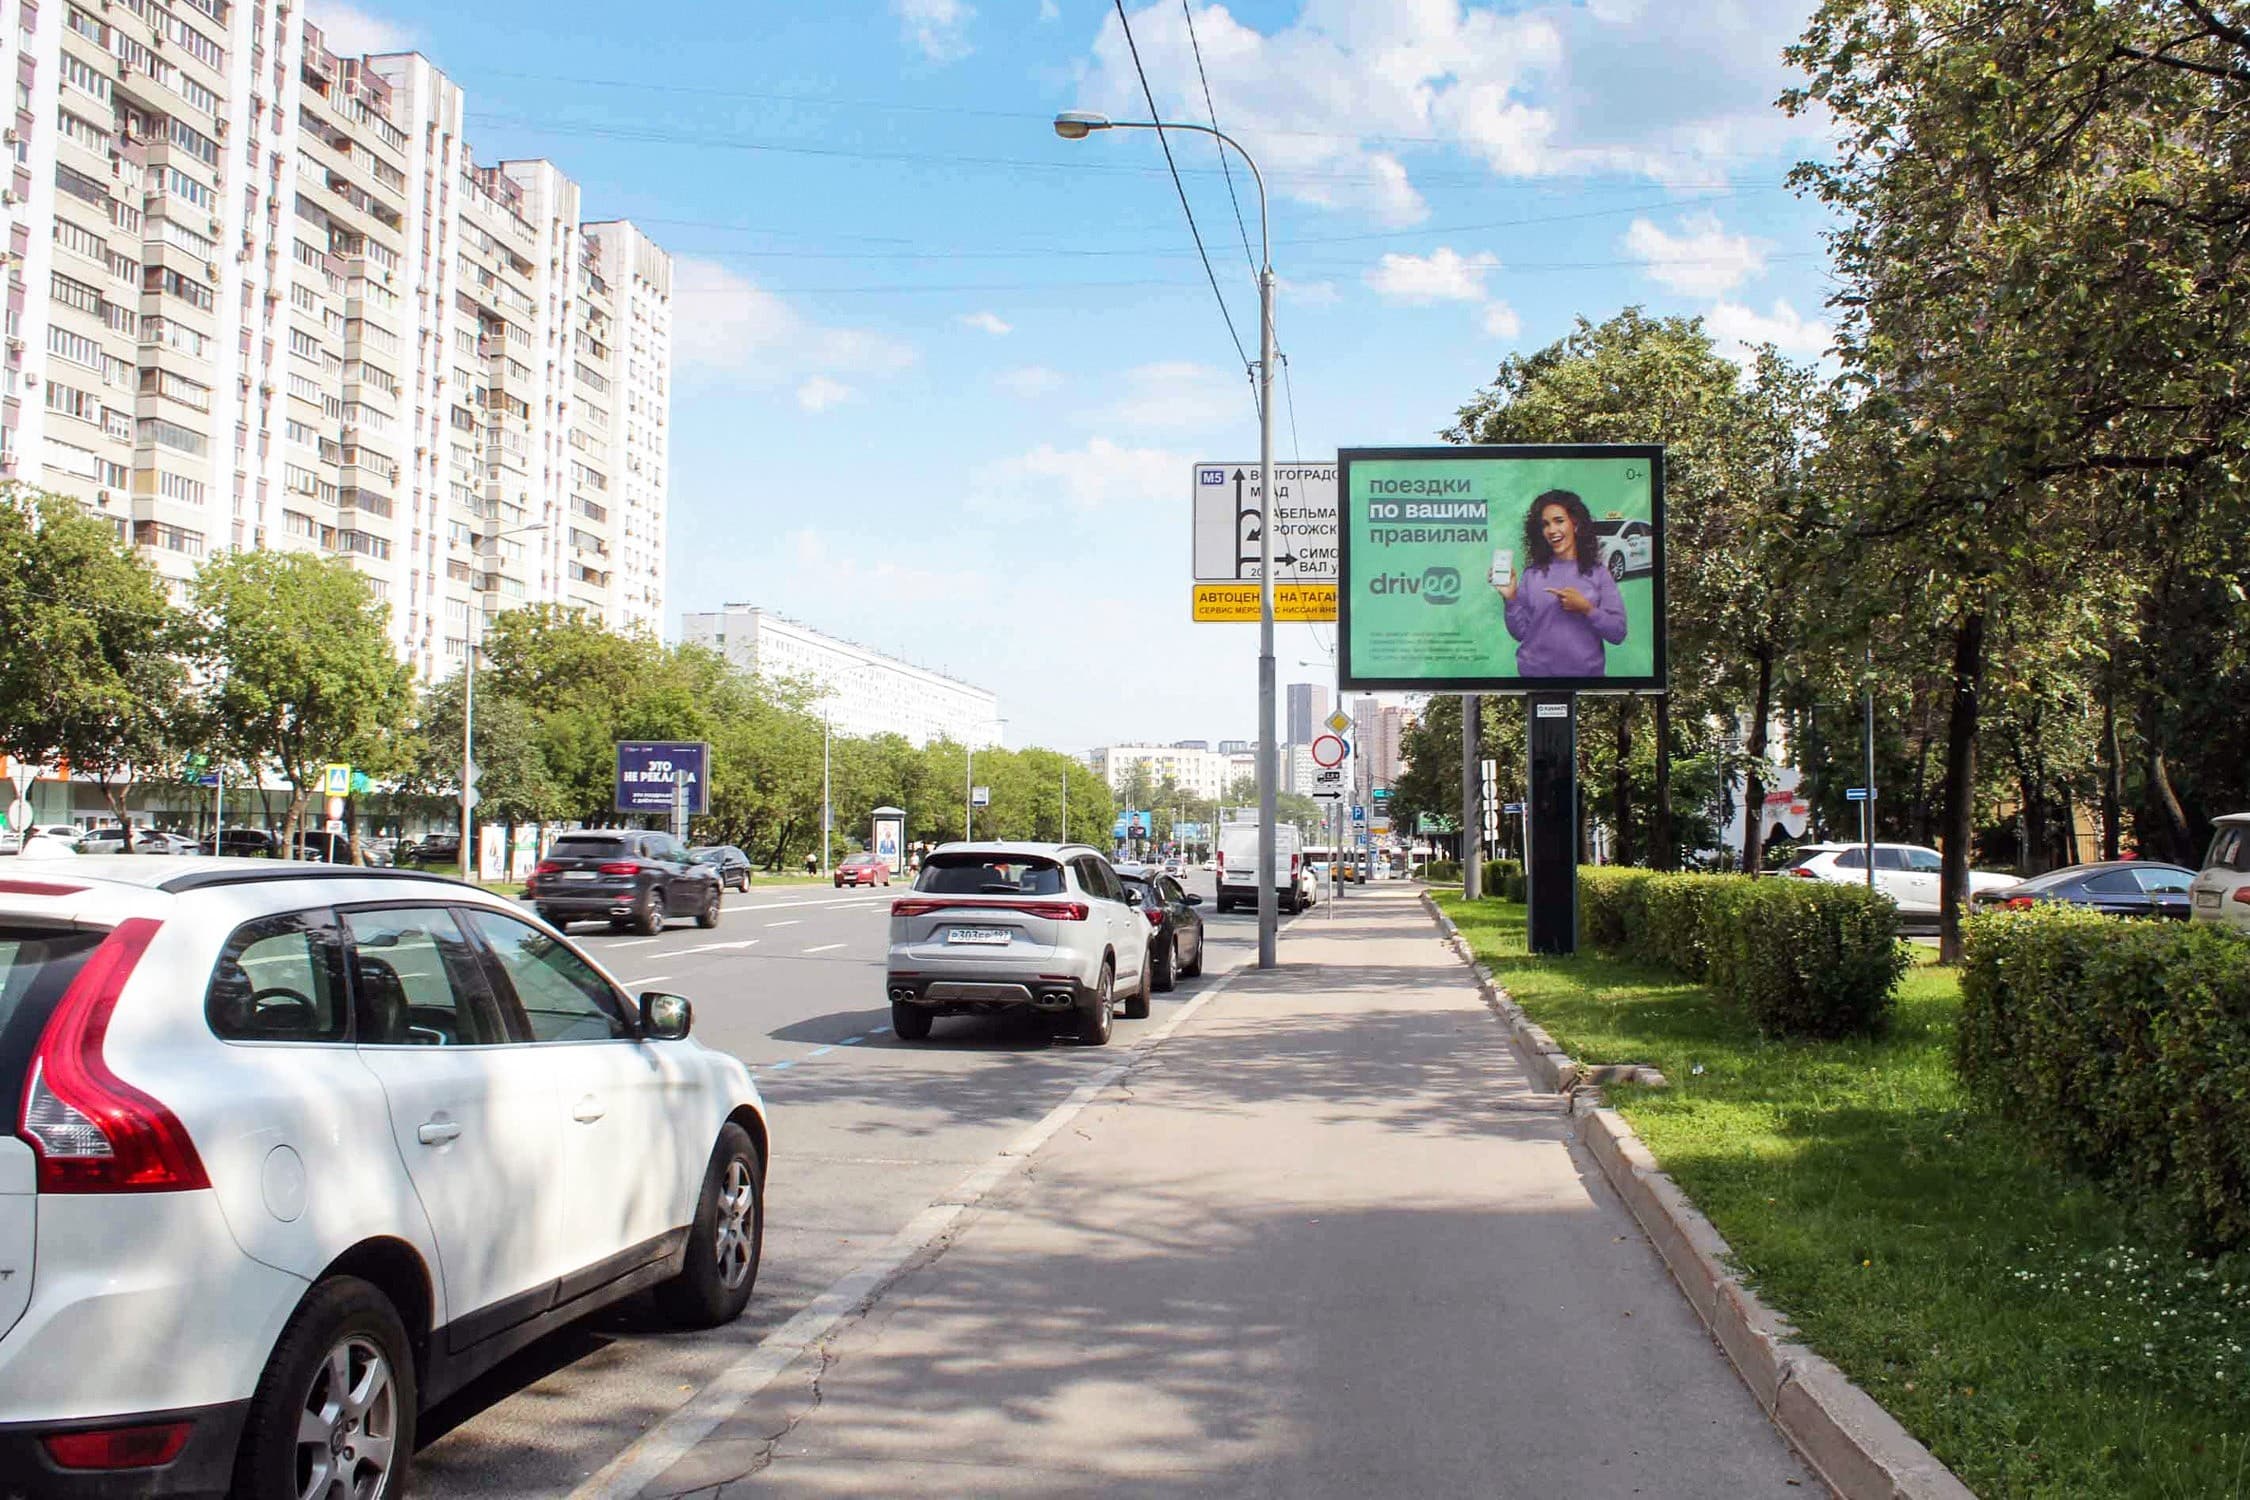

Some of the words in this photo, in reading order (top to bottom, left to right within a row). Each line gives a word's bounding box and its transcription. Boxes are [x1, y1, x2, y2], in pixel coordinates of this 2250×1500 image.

[1626, 468, 1643, 480] 0+
[1369, 479, 1471, 496] поездки
[1369, 503, 1399, 518] по
[1405, 503, 1486, 518] вашим
[1370, 528, 1488, 547] правилам
[1300, 561, 1327, 572] ВАЛ
[1280, 592, 1298, 602] НА
[648, 761, 673, 771] ЭТО
[623, 771, 638, 782] НЕ
